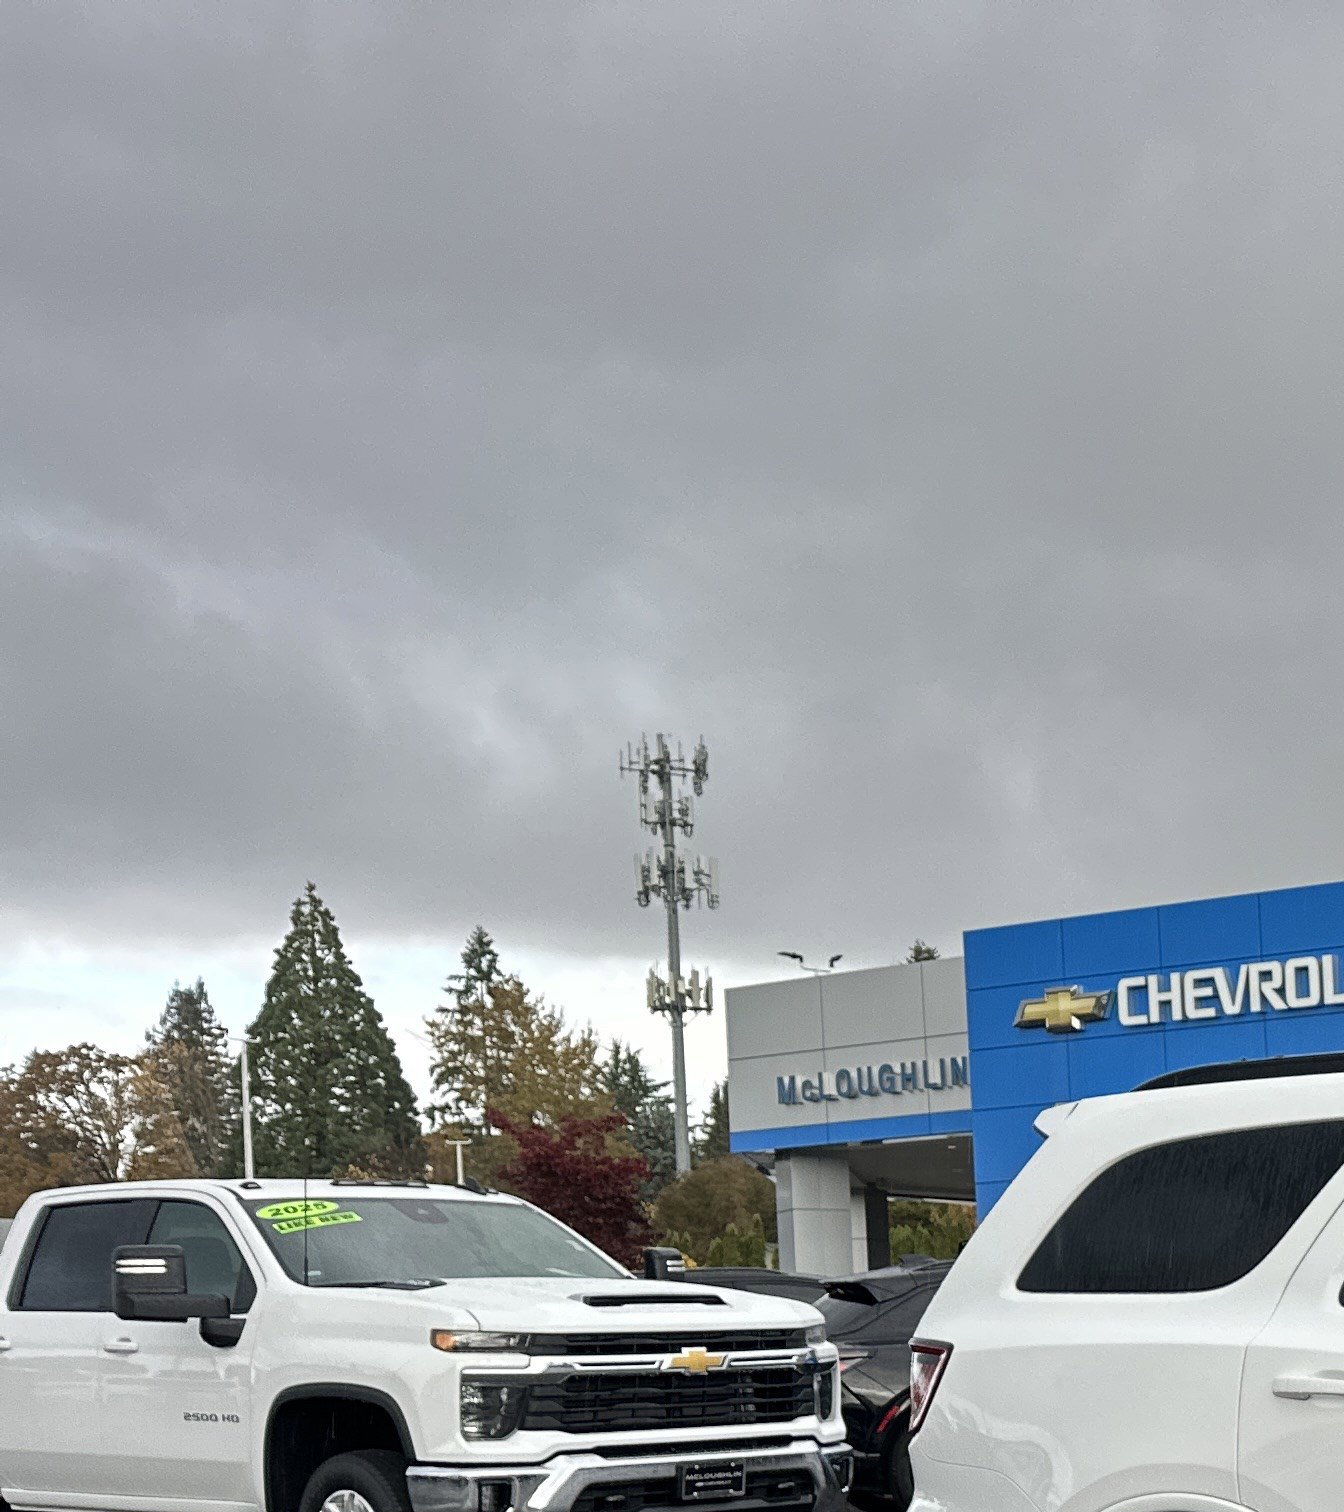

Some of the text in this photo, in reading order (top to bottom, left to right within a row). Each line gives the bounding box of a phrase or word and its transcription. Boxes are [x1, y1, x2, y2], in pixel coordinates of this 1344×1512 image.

[776, 1056, 968, 1106] McLOUGHLIN
[183, 1411, 240, 1424] 2500 HD
